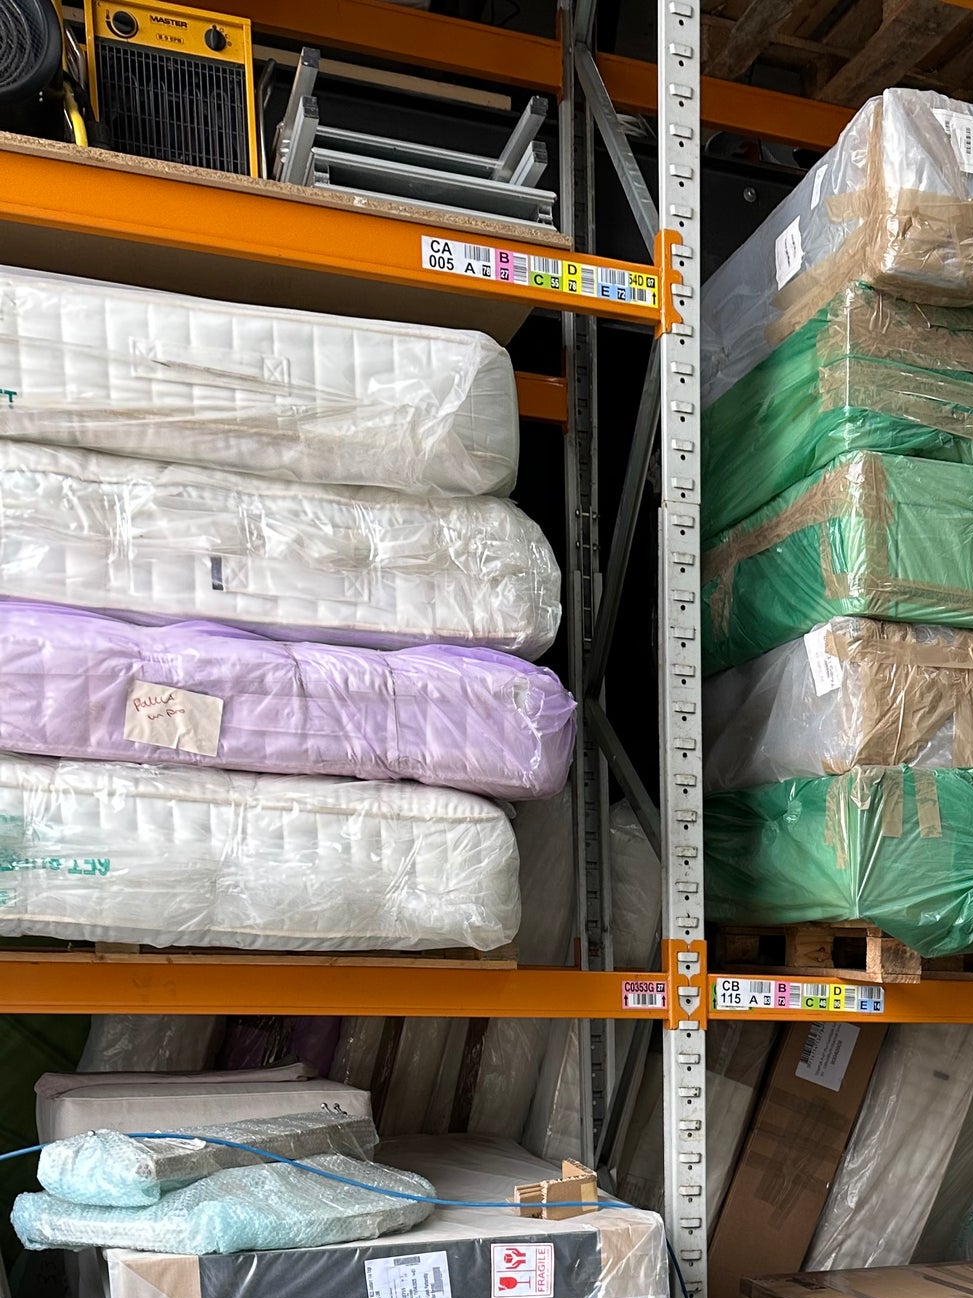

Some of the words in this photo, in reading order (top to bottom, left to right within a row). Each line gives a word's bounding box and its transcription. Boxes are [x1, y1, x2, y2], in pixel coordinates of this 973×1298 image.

[150, 15, 188, 28] MASTER
[430, 240, 452, 256] CA
[429, 255, 454, 270] 005
[499, 252, 510, 263] B
[464, 262, 476, 274] A
[568, 264, 577, 275] D
[533, 274, 544, 285] C
[601, 286, 610, 297] E
[624, 982, 655, 992] C0353G
[722, 980, 740, 992] CB
[778, 983, 787, 993] B
[833, 986, 842, 996] D
[721, 993, 741, 1004] 115
[749, 995, 758, 1005] A
[805, 998, 814, 1008] C
[860, 1000, 868, 1010] E
[537, 1248, 546, 1293] FRAGILE
